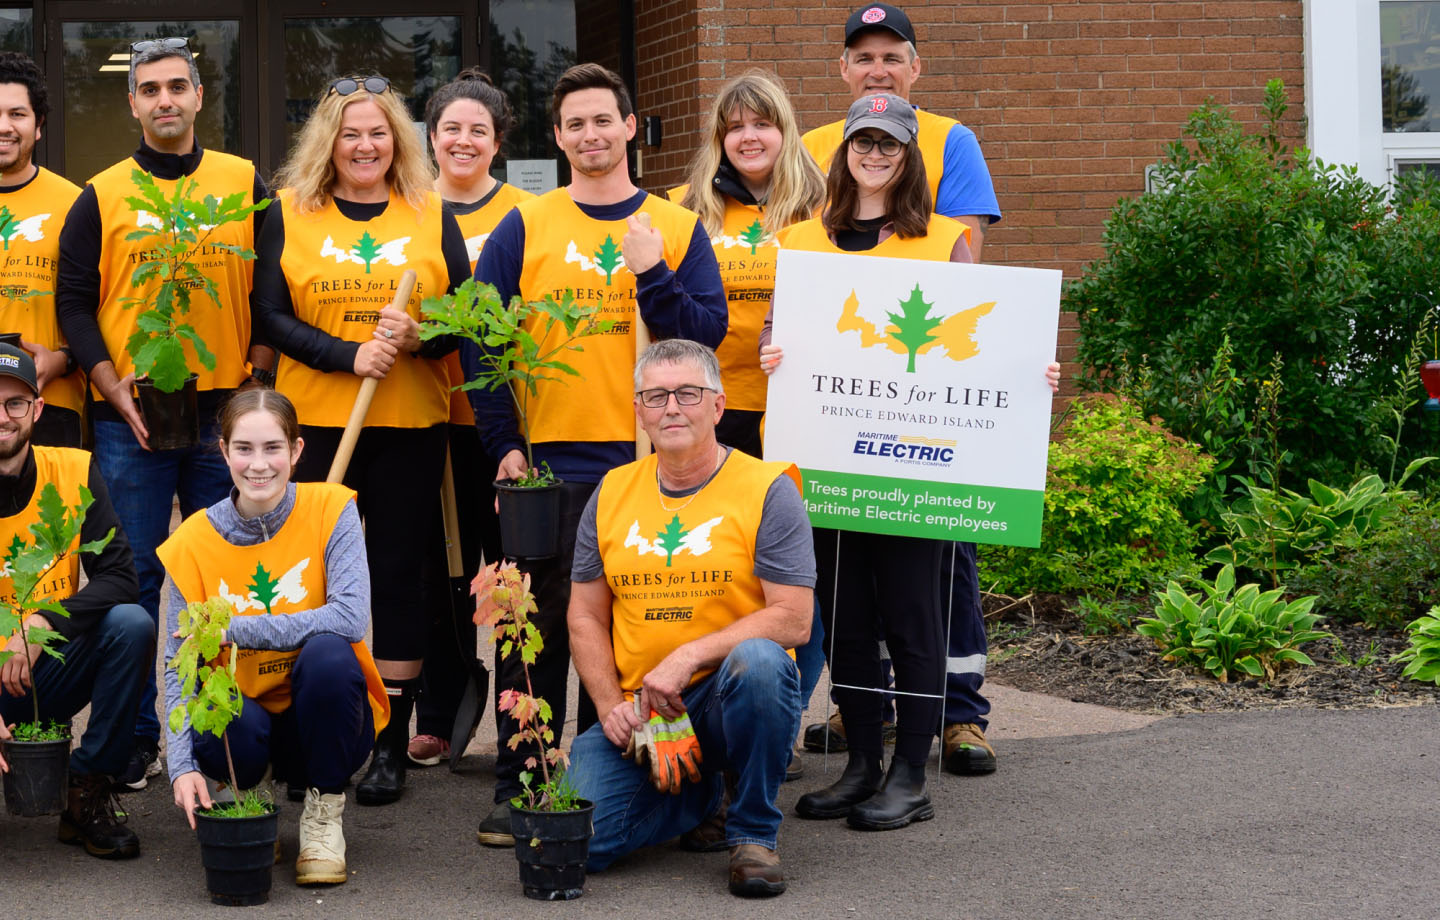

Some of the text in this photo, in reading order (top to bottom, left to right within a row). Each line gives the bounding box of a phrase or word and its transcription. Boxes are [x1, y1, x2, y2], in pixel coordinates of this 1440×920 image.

[869, 97, 888, 112] B
[4, 256, 21, 268] for
[25, 255, 57, 271] LIFE
[718, 259, 769, 272] EES for
[311, 279, 423, 294] TREES for LE
[318, 296, 347, 305] PRINCE
[553, 288, 603, 300] TEES
[608, 291, 624, 303] for
[343, 314, 382, 322] ELECTR
[812, 374, 1009, 409] TREES for LIFE
[821, 405, 995, 430] PRINCE EDWARD ISLAND
[857, 431, 898, 442] MARITIME
[853, 440, 954, 463] ELECTRIC
[809, 480, 996, 514] Trees proudly planted by
[865, 505, 921, 524] Electric
[925, 513, 1008, 531] employees
[612, 570, 733, 587] TREES for LIFE
[621, 589, 725, 600] PRINCE EDWARD ISLAND
[644, 611, 693, 621] ELECTRIC
[258, 661, 295, 675] ELECTRI
